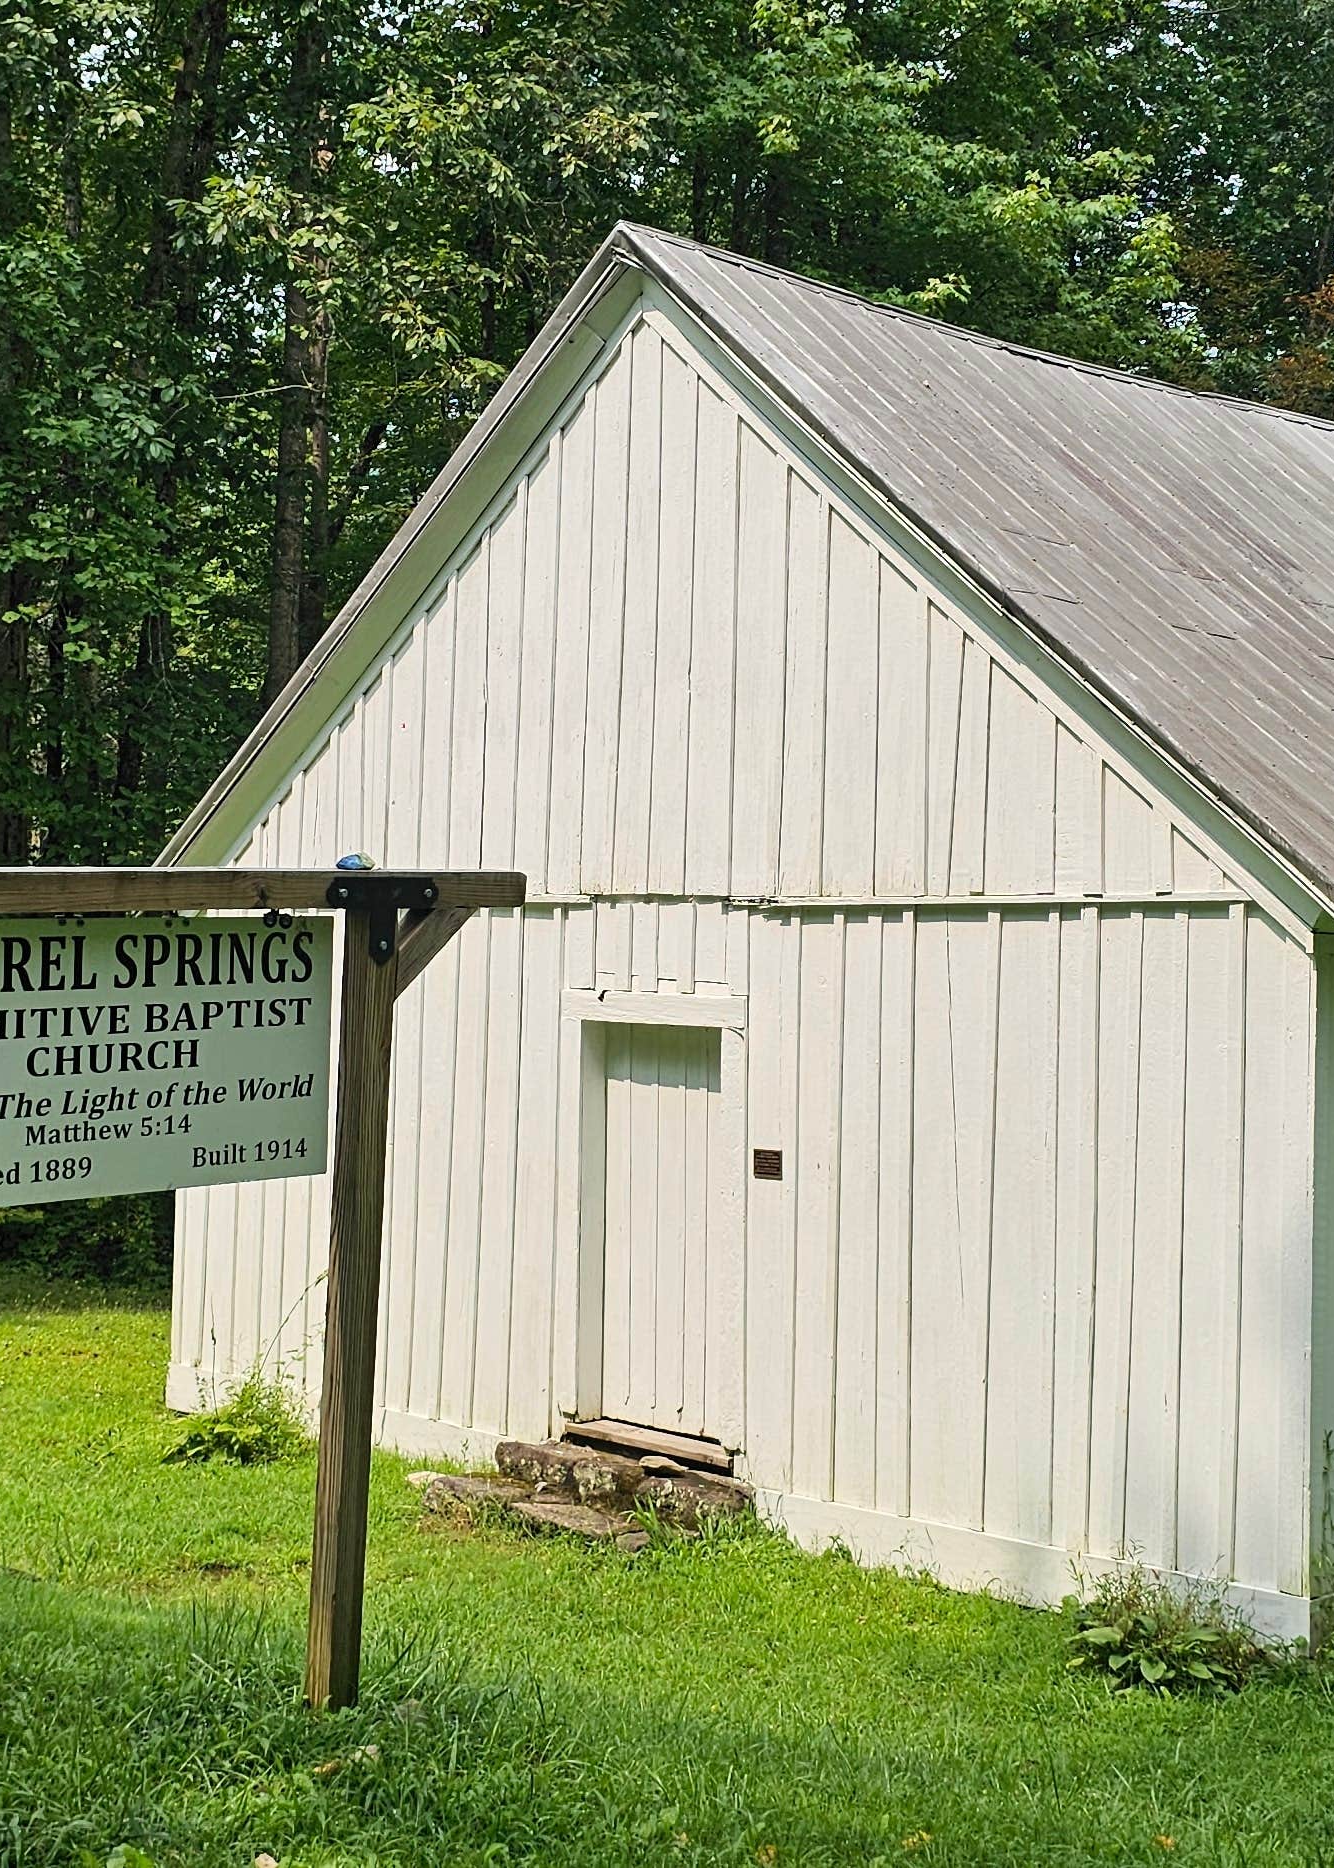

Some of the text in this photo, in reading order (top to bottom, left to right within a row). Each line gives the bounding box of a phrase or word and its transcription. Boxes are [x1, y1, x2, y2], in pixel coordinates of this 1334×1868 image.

[112, 931, 315, 989] SPRINGS
[143, 997, 314, 1033] BAPTIST
[25, 1038, 201, 1079] CHURCH
[59, 1085, 141, 1121] Light
[146, 1081, 181, 1112] of
[182, 1079, 228, 1107] the
[236, 1072, 316, 1104] World
[24, 1113, 194, 1148] Matthew 5:14
[28, 1155, 93, 1185] 1889
[191, 1136, 309, 1169] Built 1914
